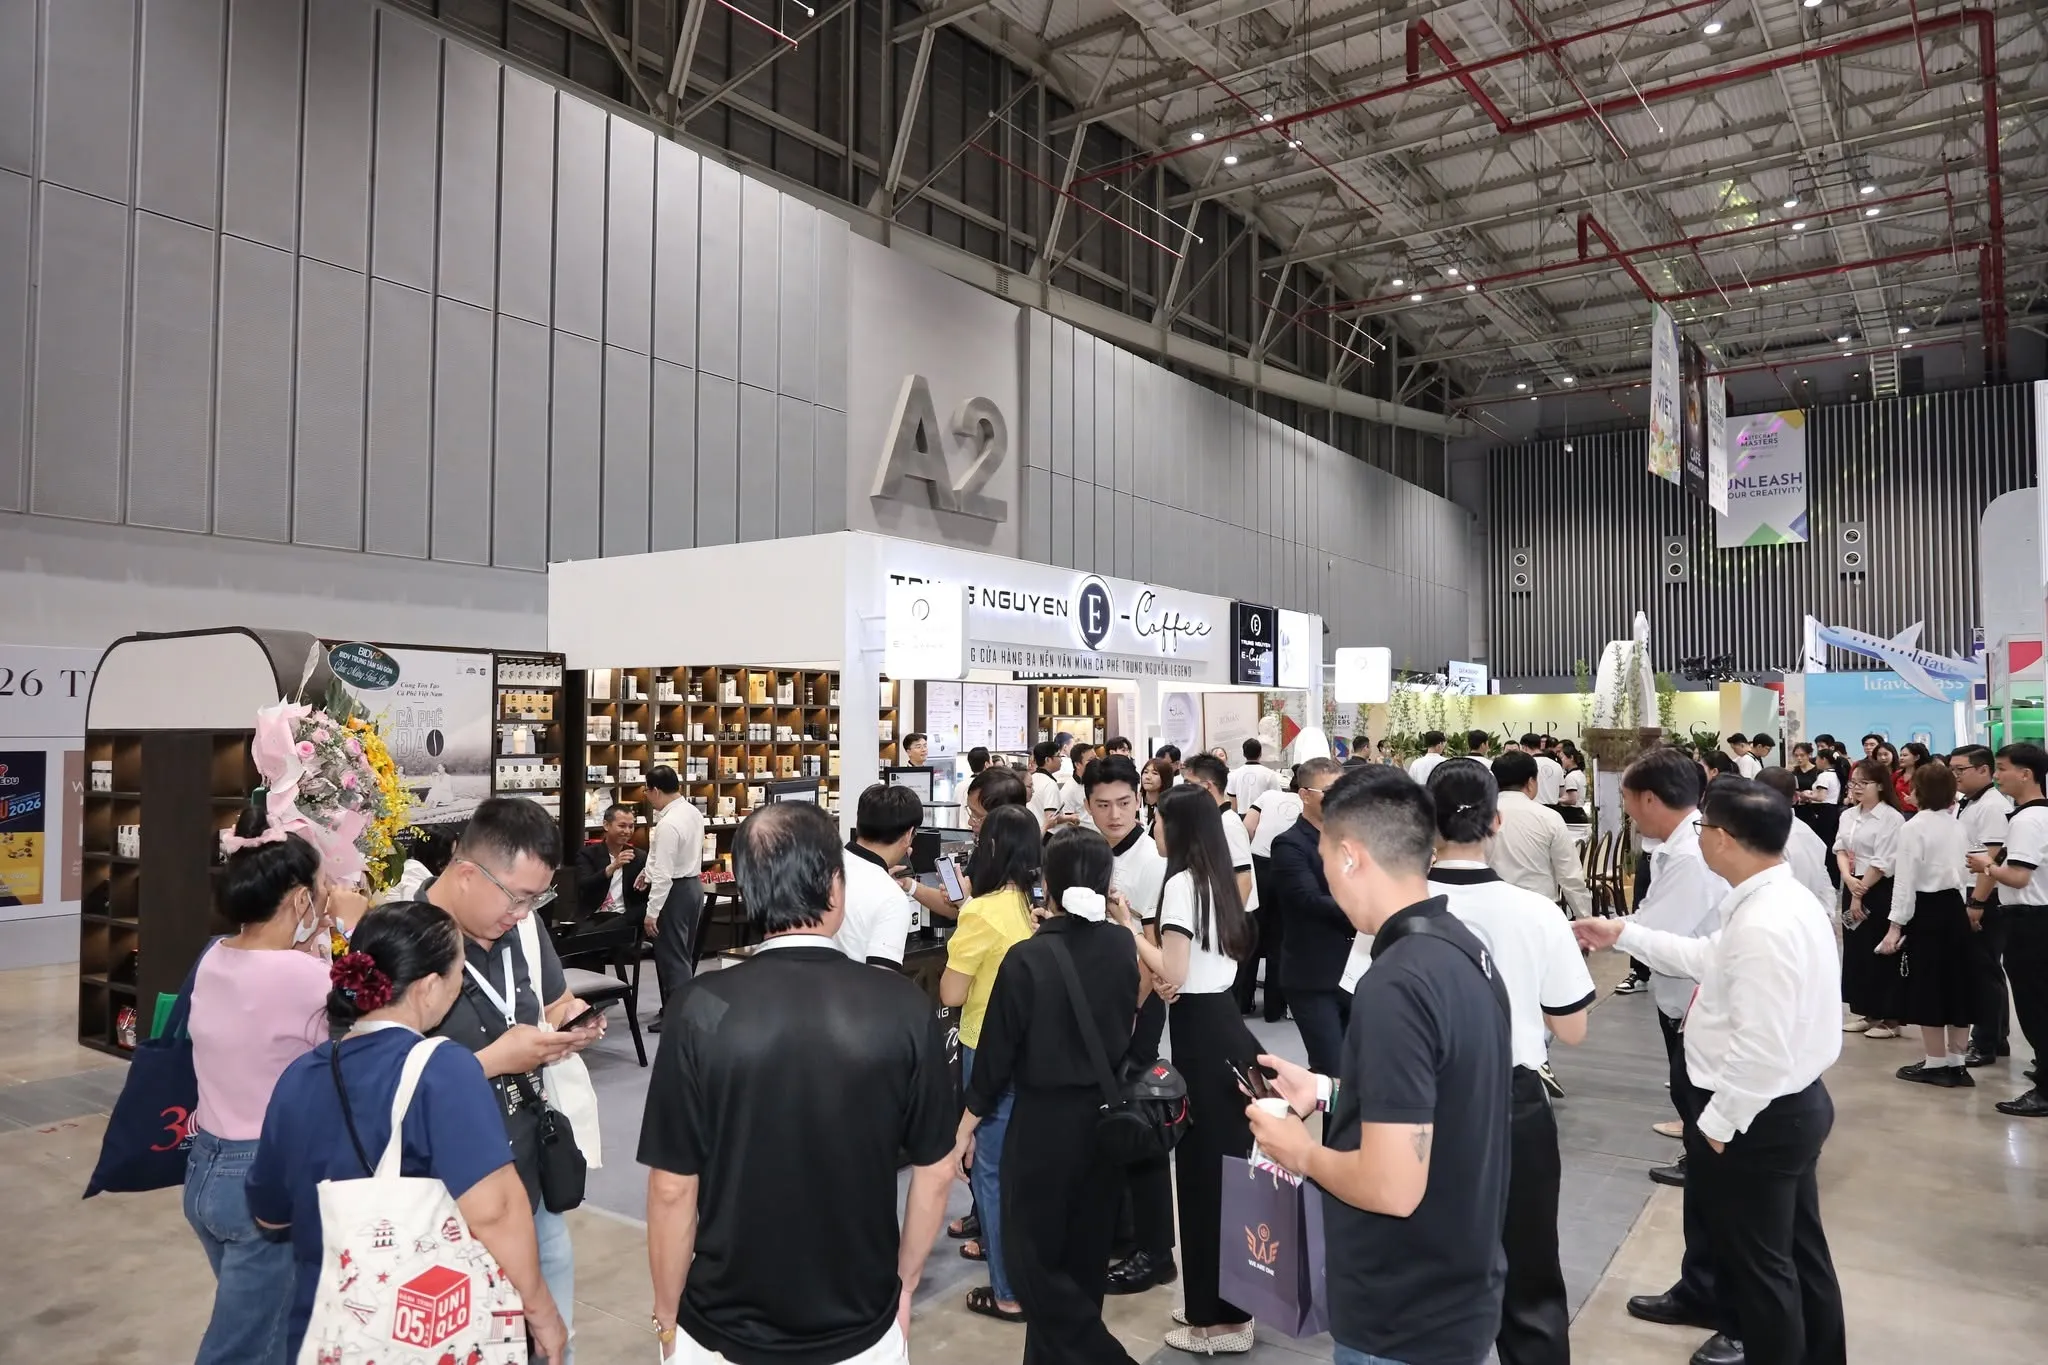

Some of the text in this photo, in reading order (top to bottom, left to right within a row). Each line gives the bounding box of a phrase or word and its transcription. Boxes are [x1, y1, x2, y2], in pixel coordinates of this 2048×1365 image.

[869, 374, 1008, 523] A2
[1740, 438, 1779, 447] MASTERS
[1749, 486, 1803, 498] CREATIVITY
[982, 588, 1068, 617] NGUYEN
[339, 650, 351, 660] BIDV
[351, 654, 367, 666] TRUNG
[357, 646, 376, 660] BIDV
[1026, 652, 1036, 667] BA
[1122, 660, 1143, 674] TRUNG
[1170, 664, 1192, 678] LEGEND
[1502, 721, 1559, 740] VIP
[9, 797, 42, 817] 2026
[438, 1287, 467, 1318] UNI
[395, 1305, 426, 1344] 05
[435, 1307, 468, 1339] QLO
